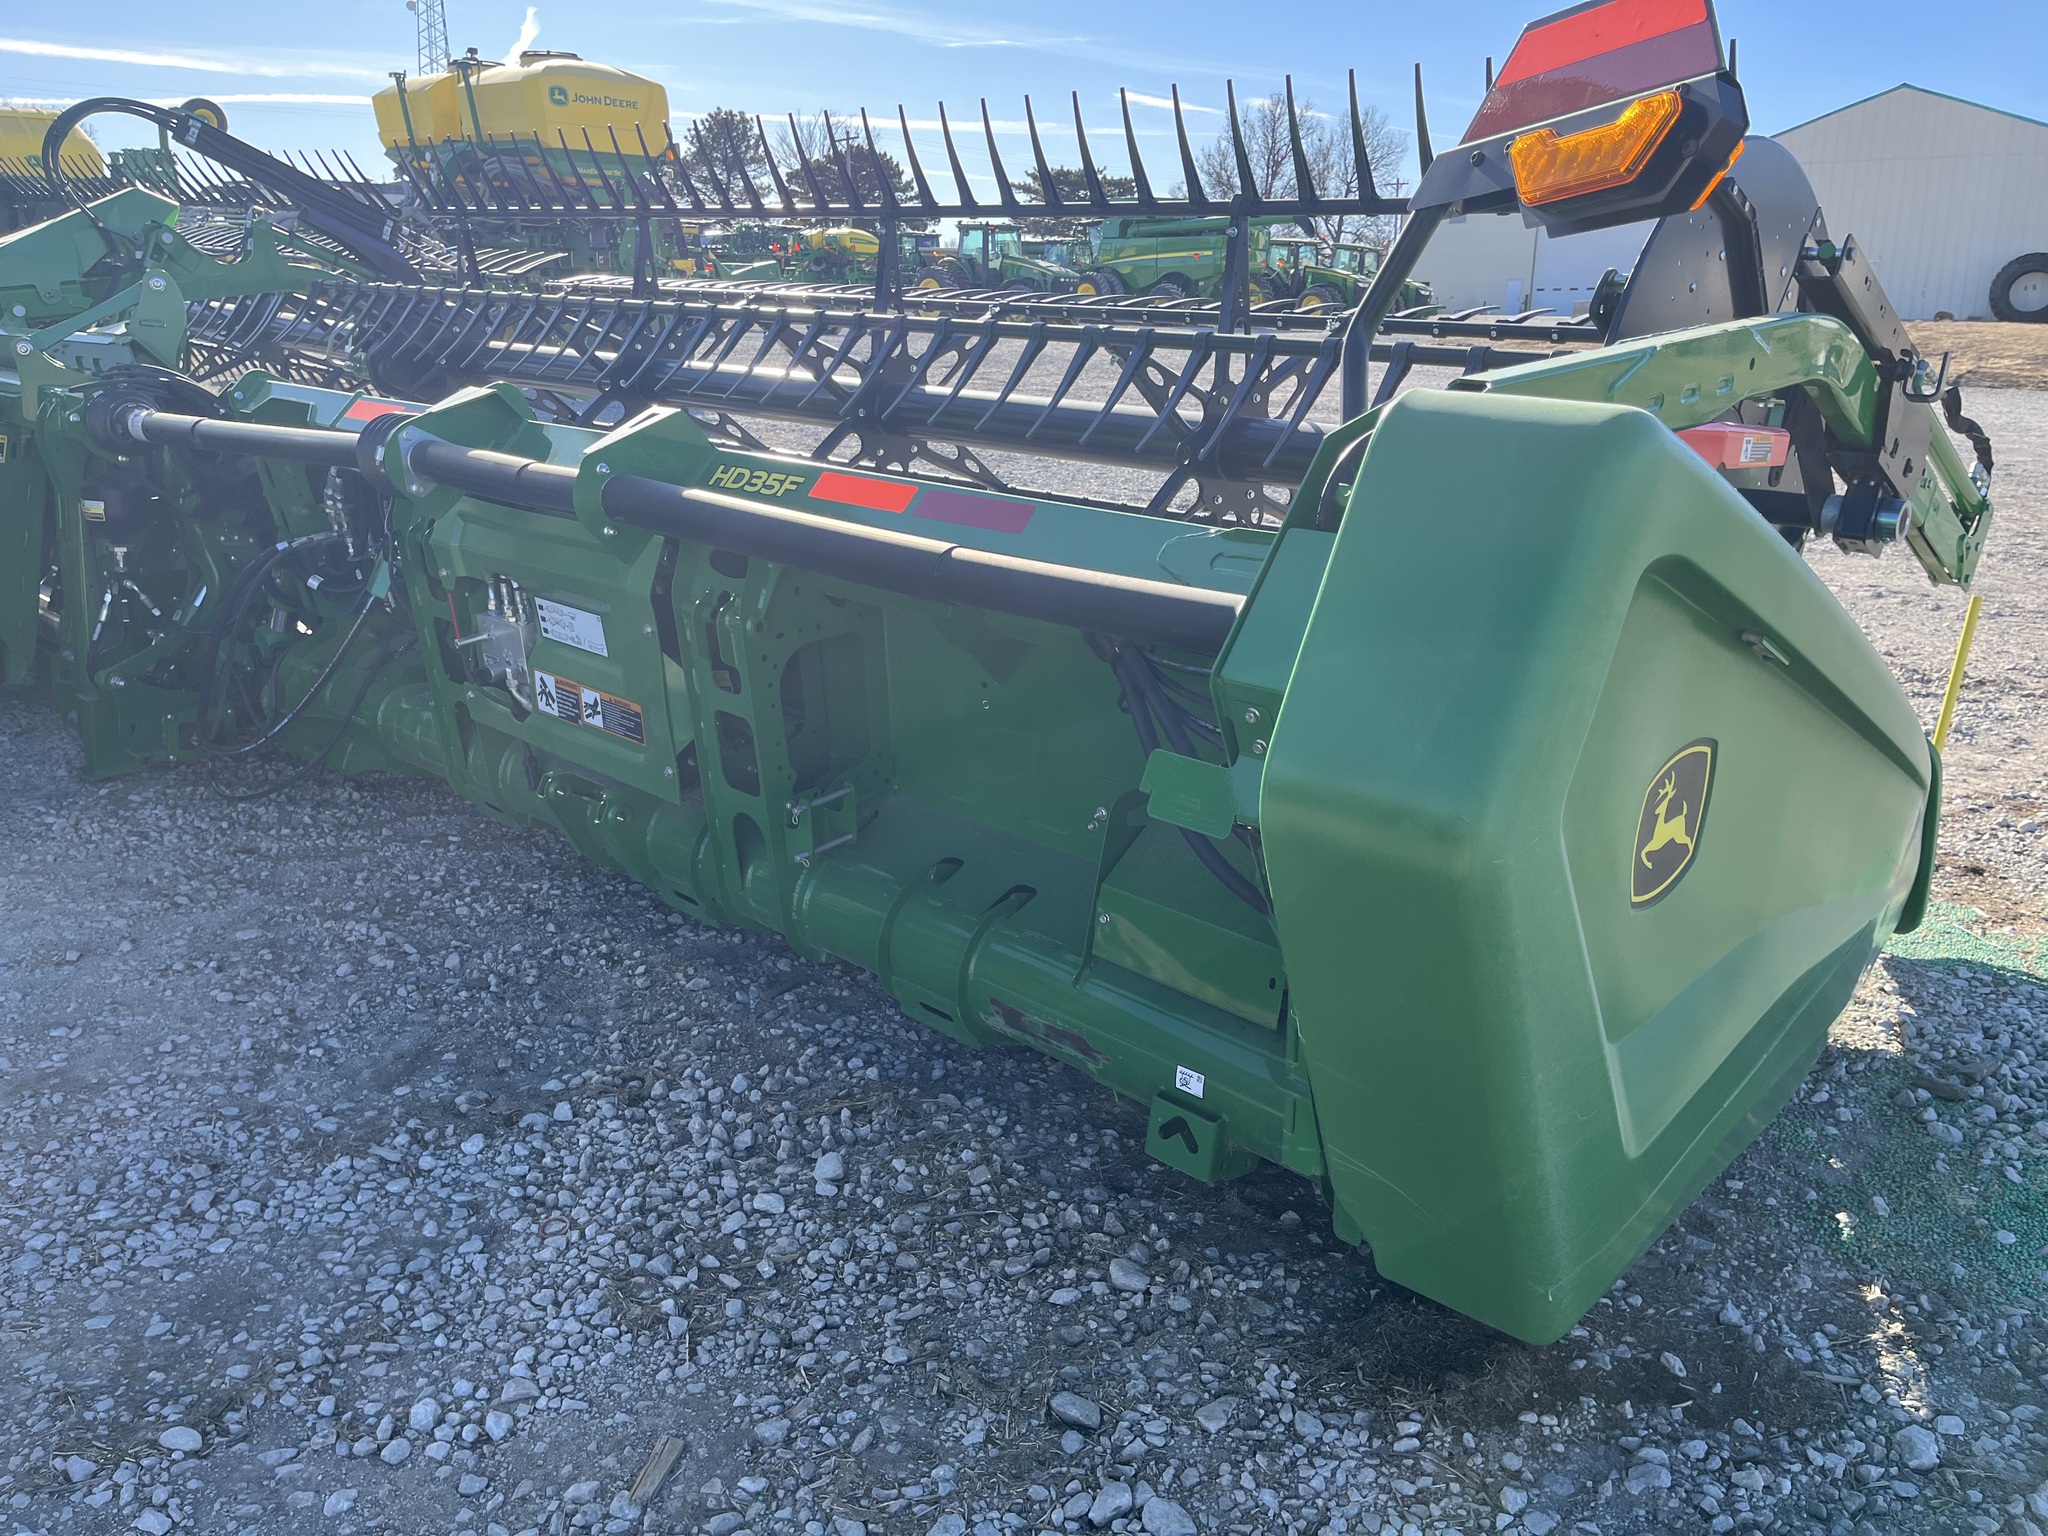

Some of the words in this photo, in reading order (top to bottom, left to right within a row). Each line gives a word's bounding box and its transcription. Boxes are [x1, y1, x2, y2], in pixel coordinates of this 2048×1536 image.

[572, 92, 602, 105] JOHN
[604, 95, 639, 110] DEERE
[708, 465, 806, 497] HD35F
